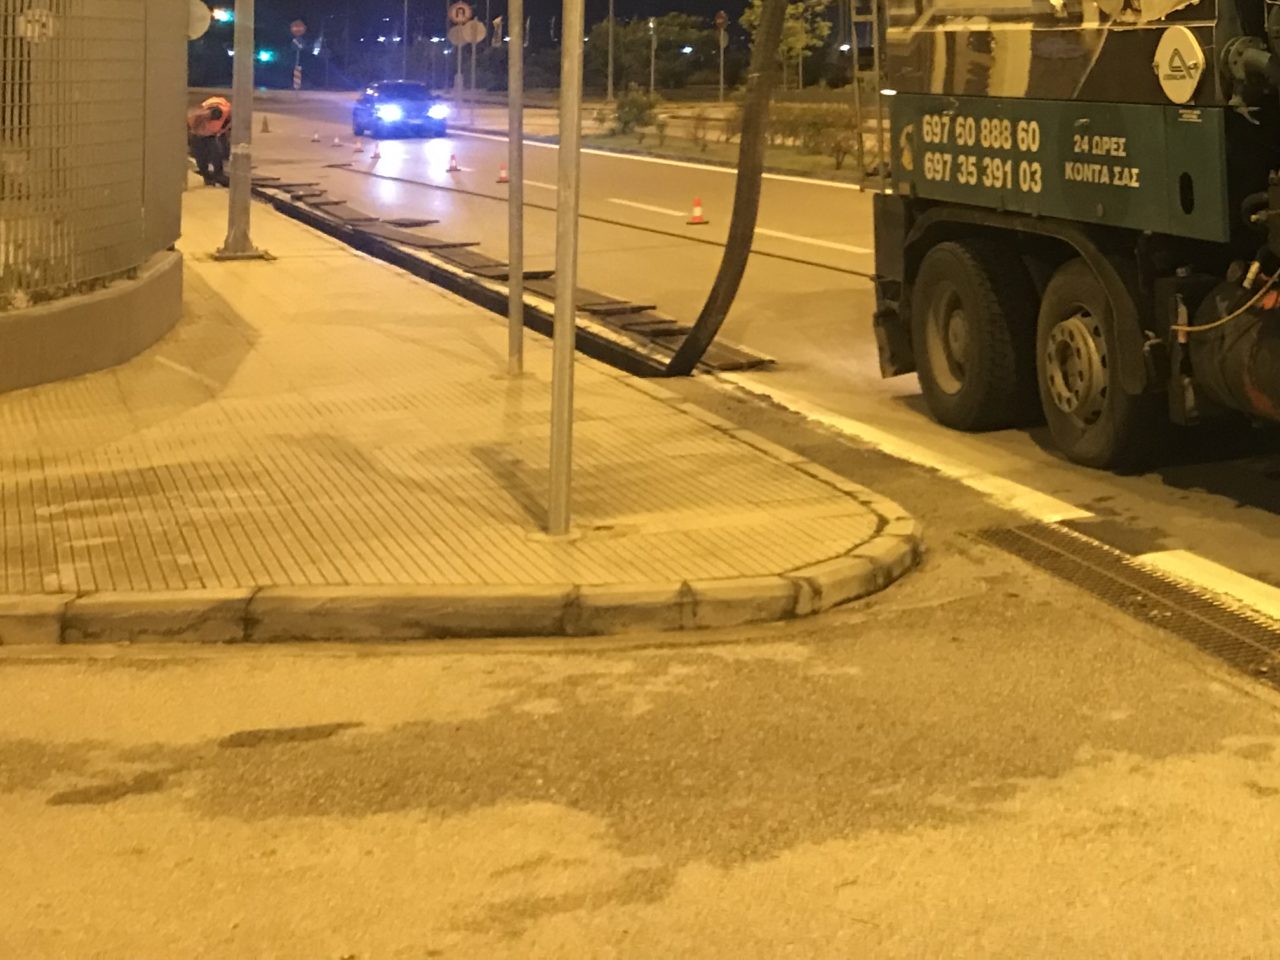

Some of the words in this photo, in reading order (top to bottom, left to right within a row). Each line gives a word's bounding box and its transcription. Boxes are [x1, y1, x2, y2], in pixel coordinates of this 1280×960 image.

[922, 113, 951, 144] 697
[980, 117, 1012, 150] 888
[1017, 120, 1040, 152] 60
[1073, 133, 1089, 154] 24
[1092, 135, 1127, 157] ΩΡΕΣ
[924, 151, 953, 182] 697
[956, 154, 978, 186] 35
[982, 156, 1013, 190] 391
[1018, 160, 1042, 194] 03
[1064, 160, 1110, 185] ΚΟΝΤΑ
[1112, 165, 1140, 188] ΣΑΣ
